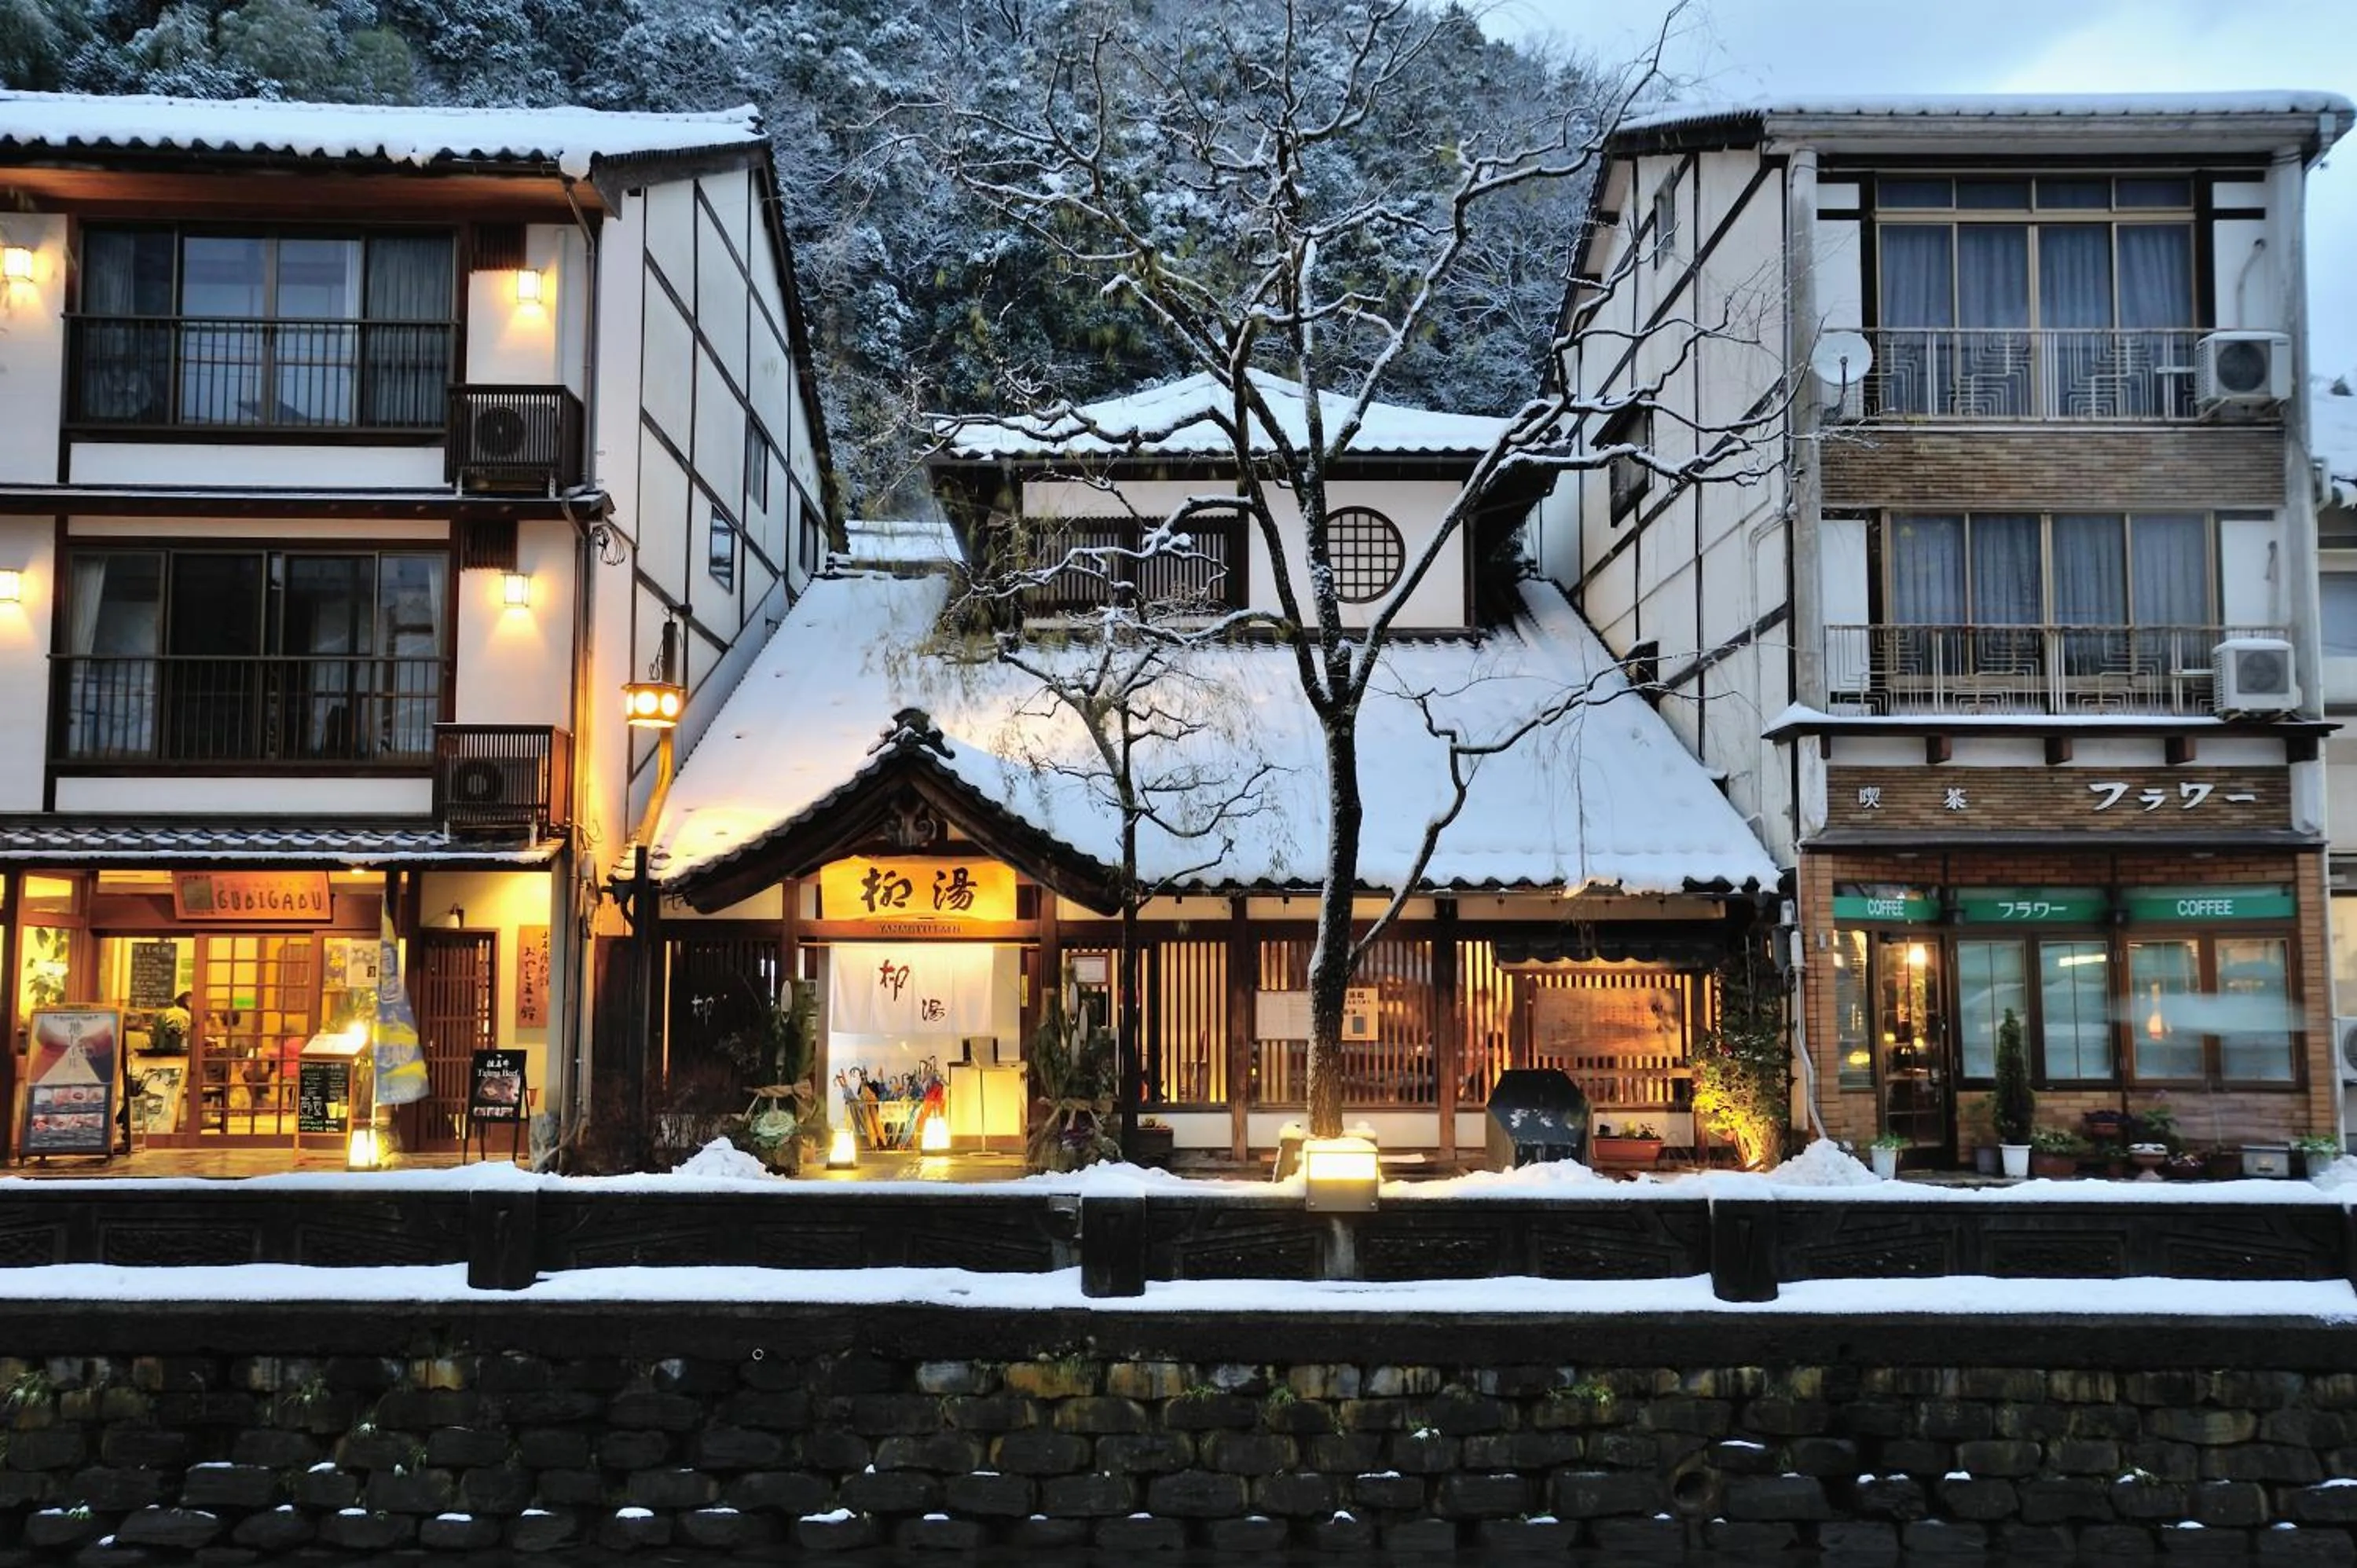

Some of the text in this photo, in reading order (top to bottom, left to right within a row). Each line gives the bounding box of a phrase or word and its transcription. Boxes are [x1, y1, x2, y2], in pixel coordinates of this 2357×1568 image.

[1858, 782, 2257, 812] 喫茶 フラワー
[860, 866, 977, 913] 柳湯
[1867, 899, 1905, 917] COFFEE
[1998, 902, 2067, 918] フラワー
[2176, 899, 2234, 917] COFFEE
